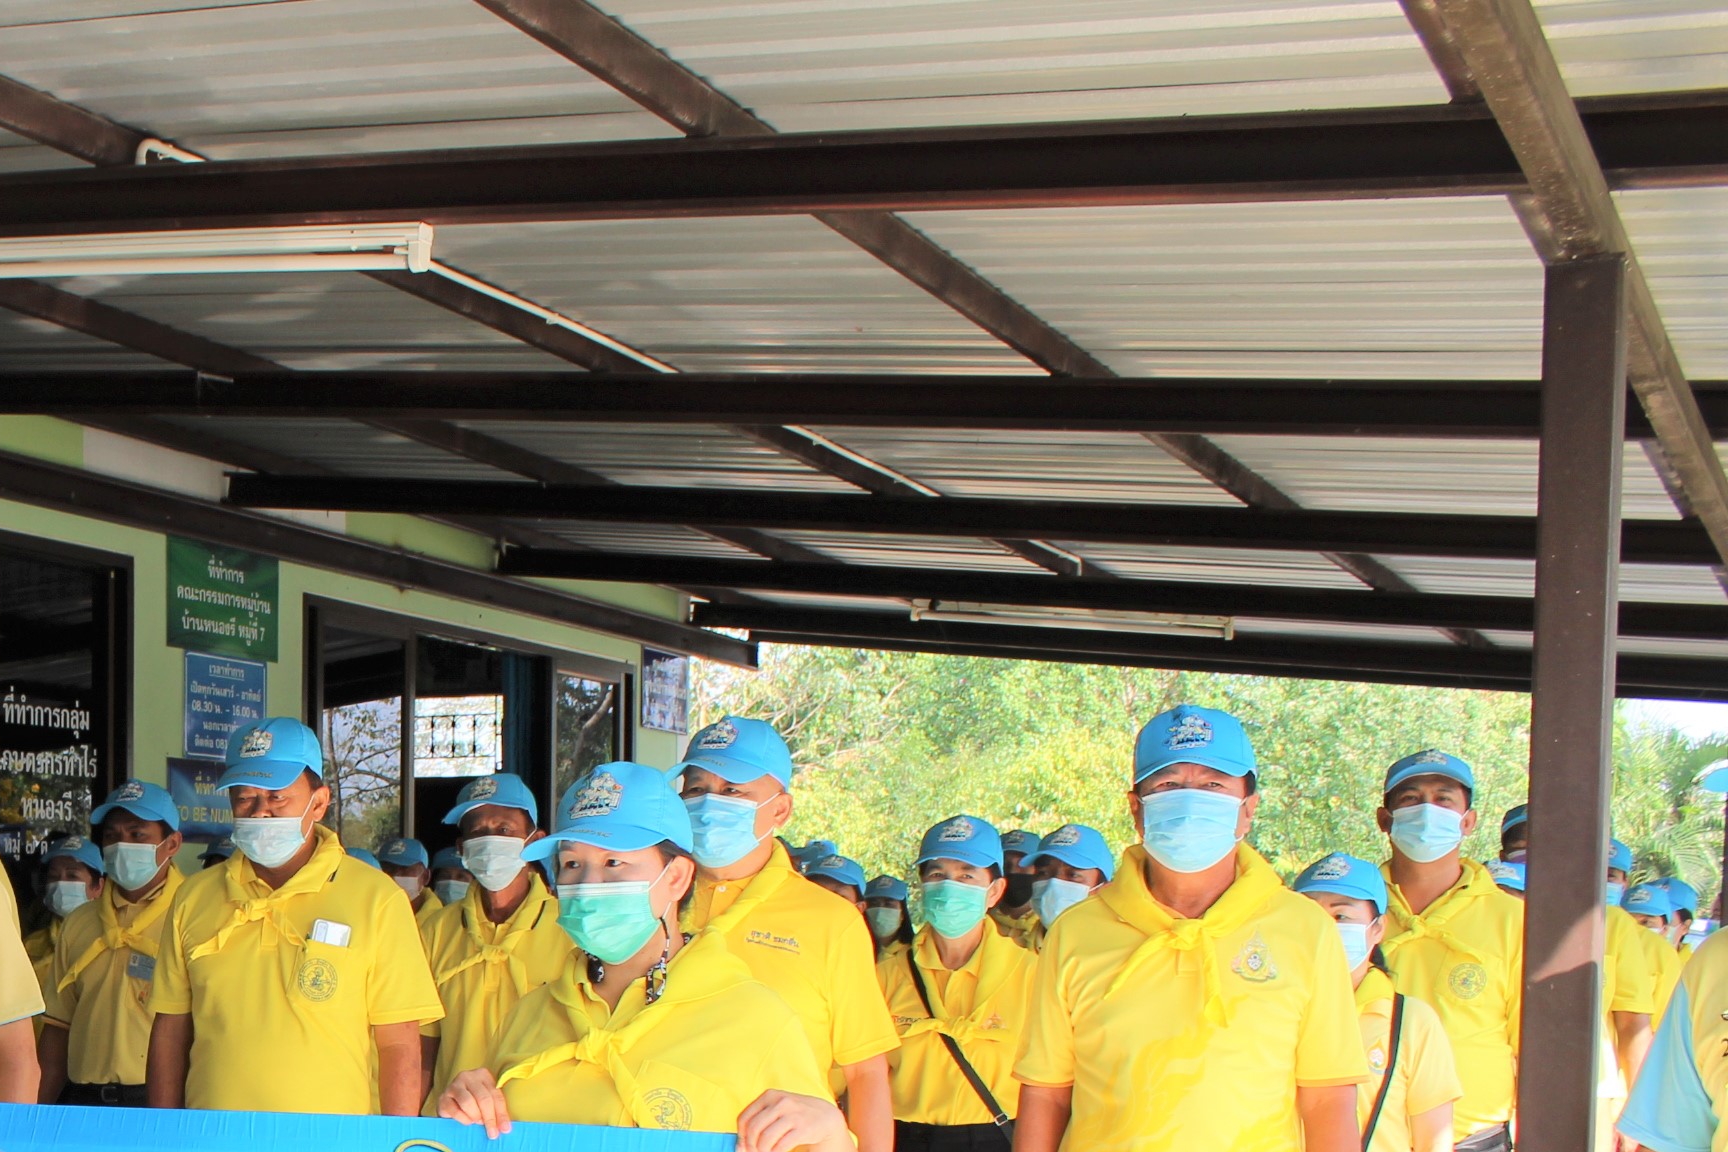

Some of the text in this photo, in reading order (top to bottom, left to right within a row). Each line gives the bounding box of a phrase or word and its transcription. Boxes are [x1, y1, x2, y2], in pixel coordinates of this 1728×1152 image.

[208, 554, 244, 584] ที่ทำการ
[177, 585, 271, 618] คณะกรรมการหมู่บ้าน
[182, 608, 266, 646] บ้านหนองรี หมู่ที่ 7
[3, 686, 90, 739] ที่ทำการกลุ่ม
[192, 699, 213, 713] 08.30
[232, 704, 251, 719] 16.00
[193, 807, 208, 822] BE
[4, 831, 21, 861] หมู่
